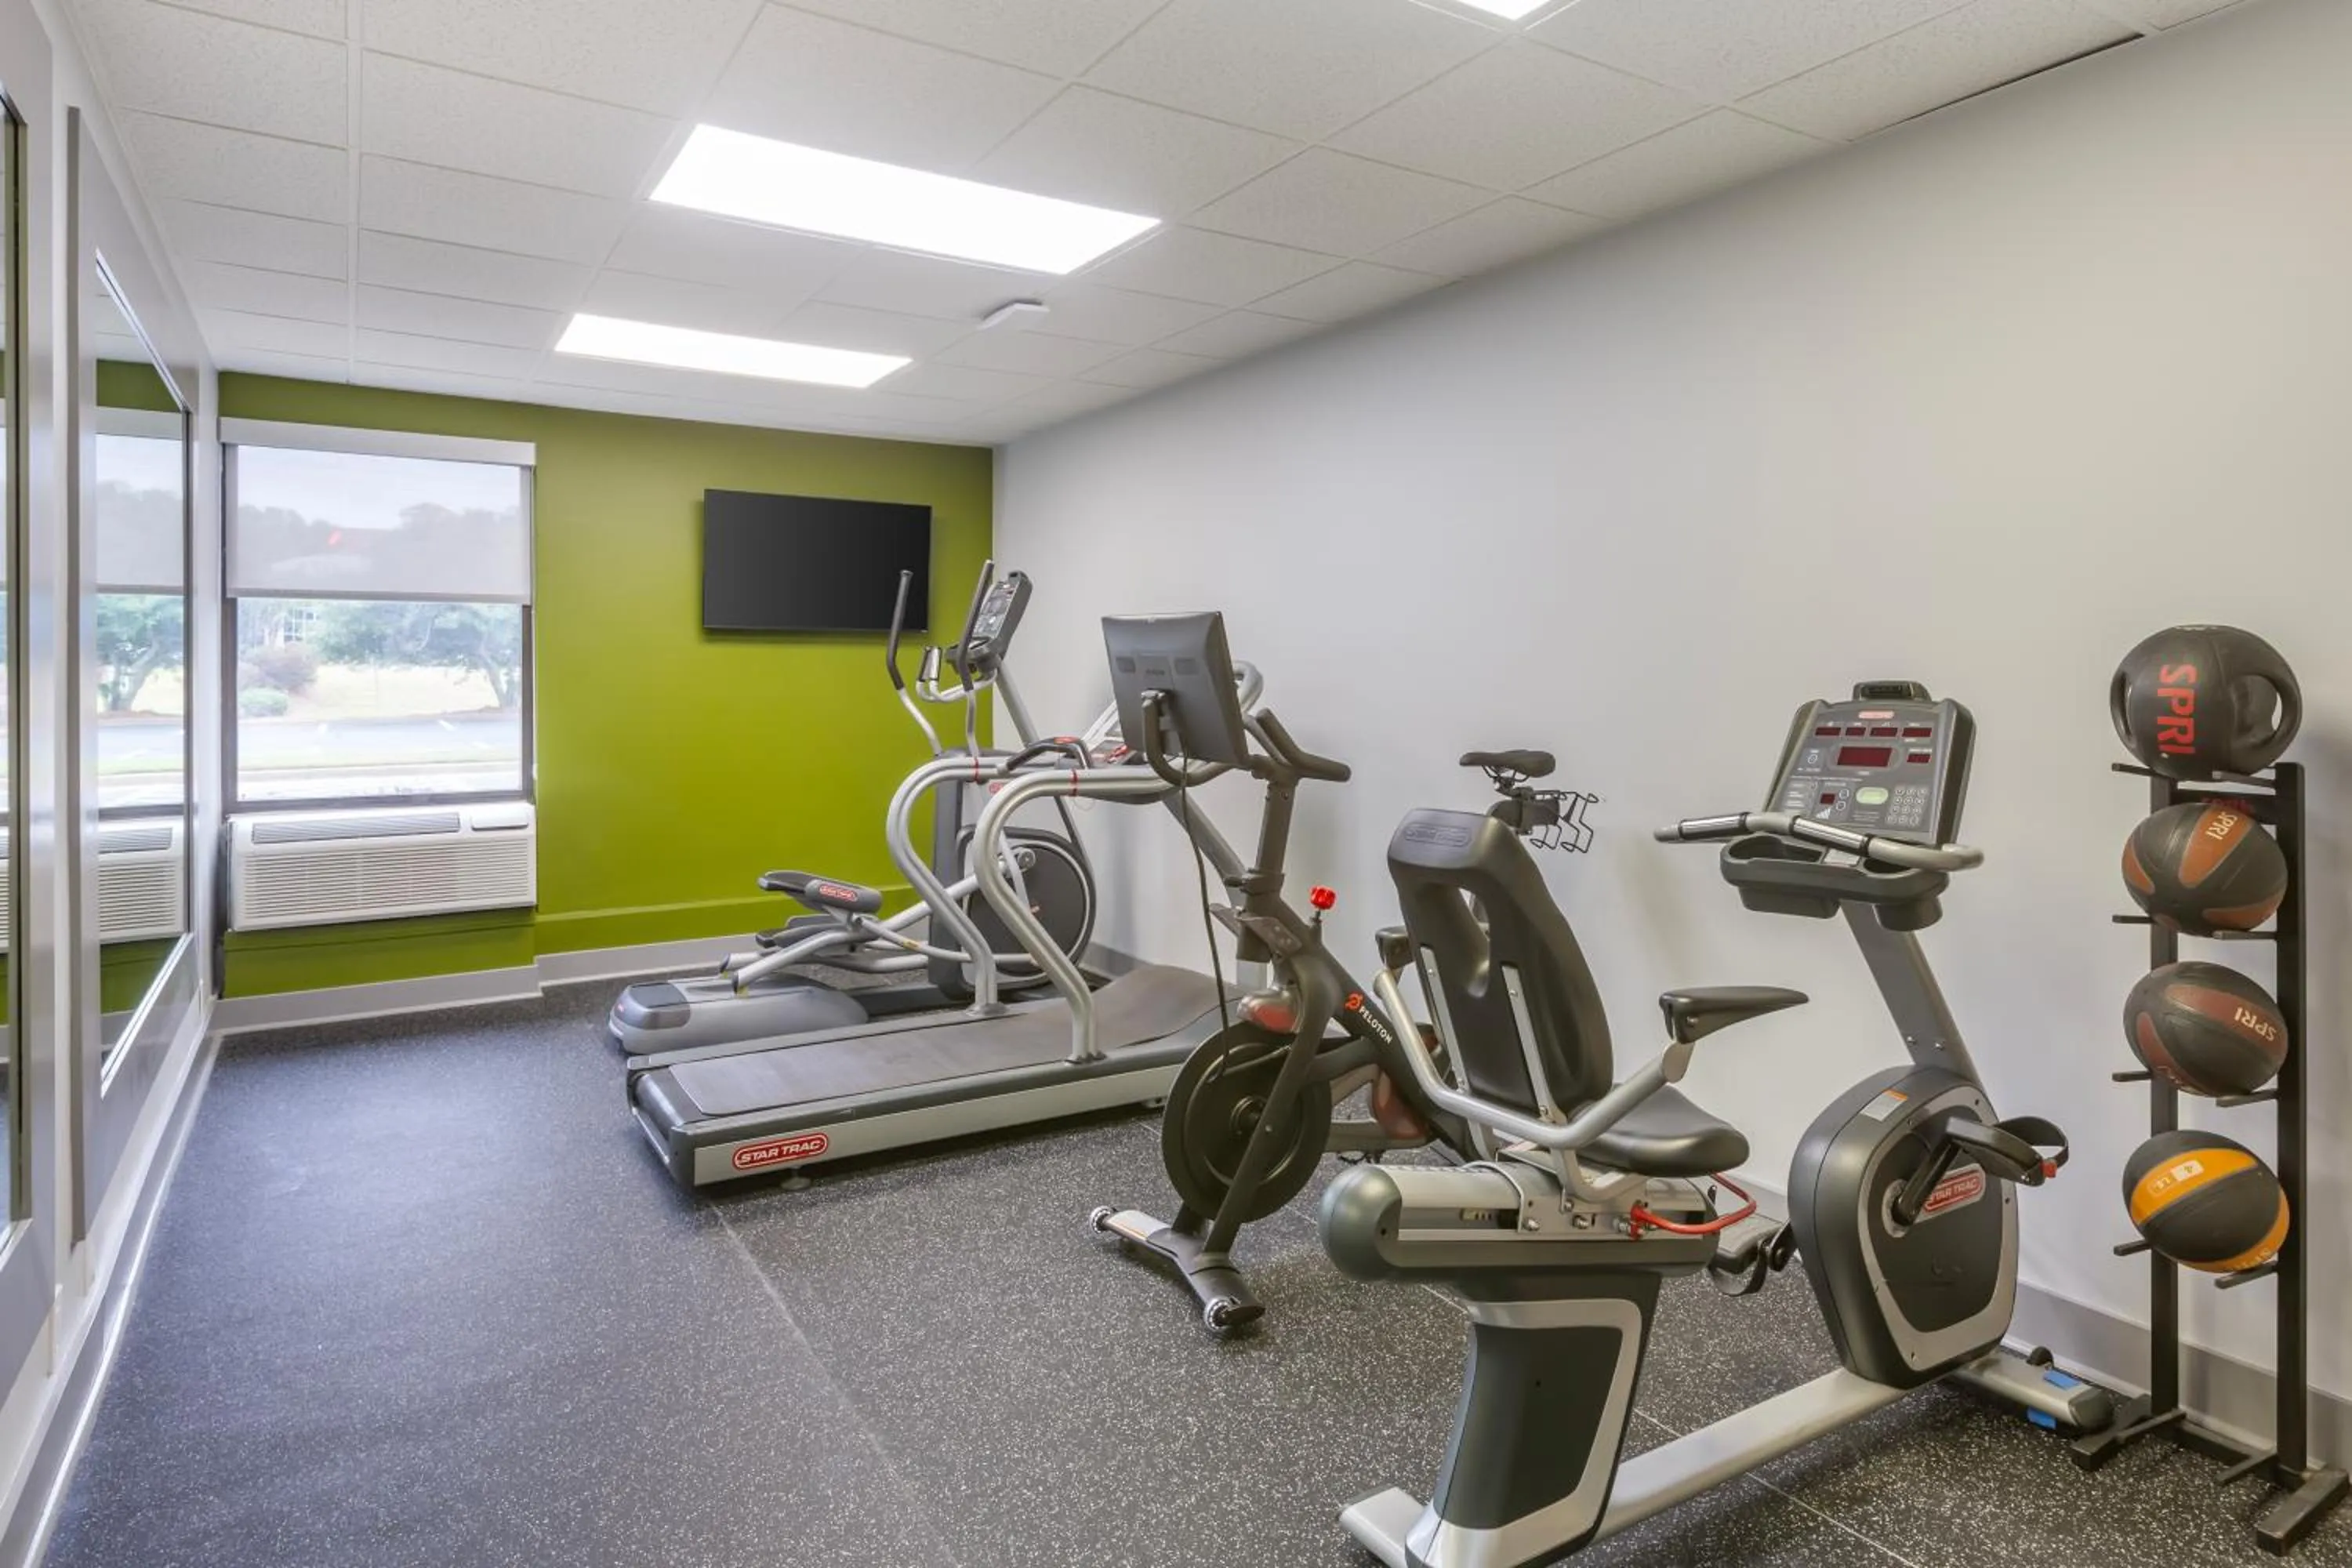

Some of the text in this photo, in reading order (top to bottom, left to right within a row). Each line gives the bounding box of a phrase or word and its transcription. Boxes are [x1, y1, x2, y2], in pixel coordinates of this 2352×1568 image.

[2158, 664, 2197, 753] SPRI
[2205, 811, 2238, 840] SPRI
[1359, 1005, 1392, 1044] PELOTON
[2234, 1007, 2277, 1041] SPRI
[740, 1141, 821, 1163] STAR TRAC
